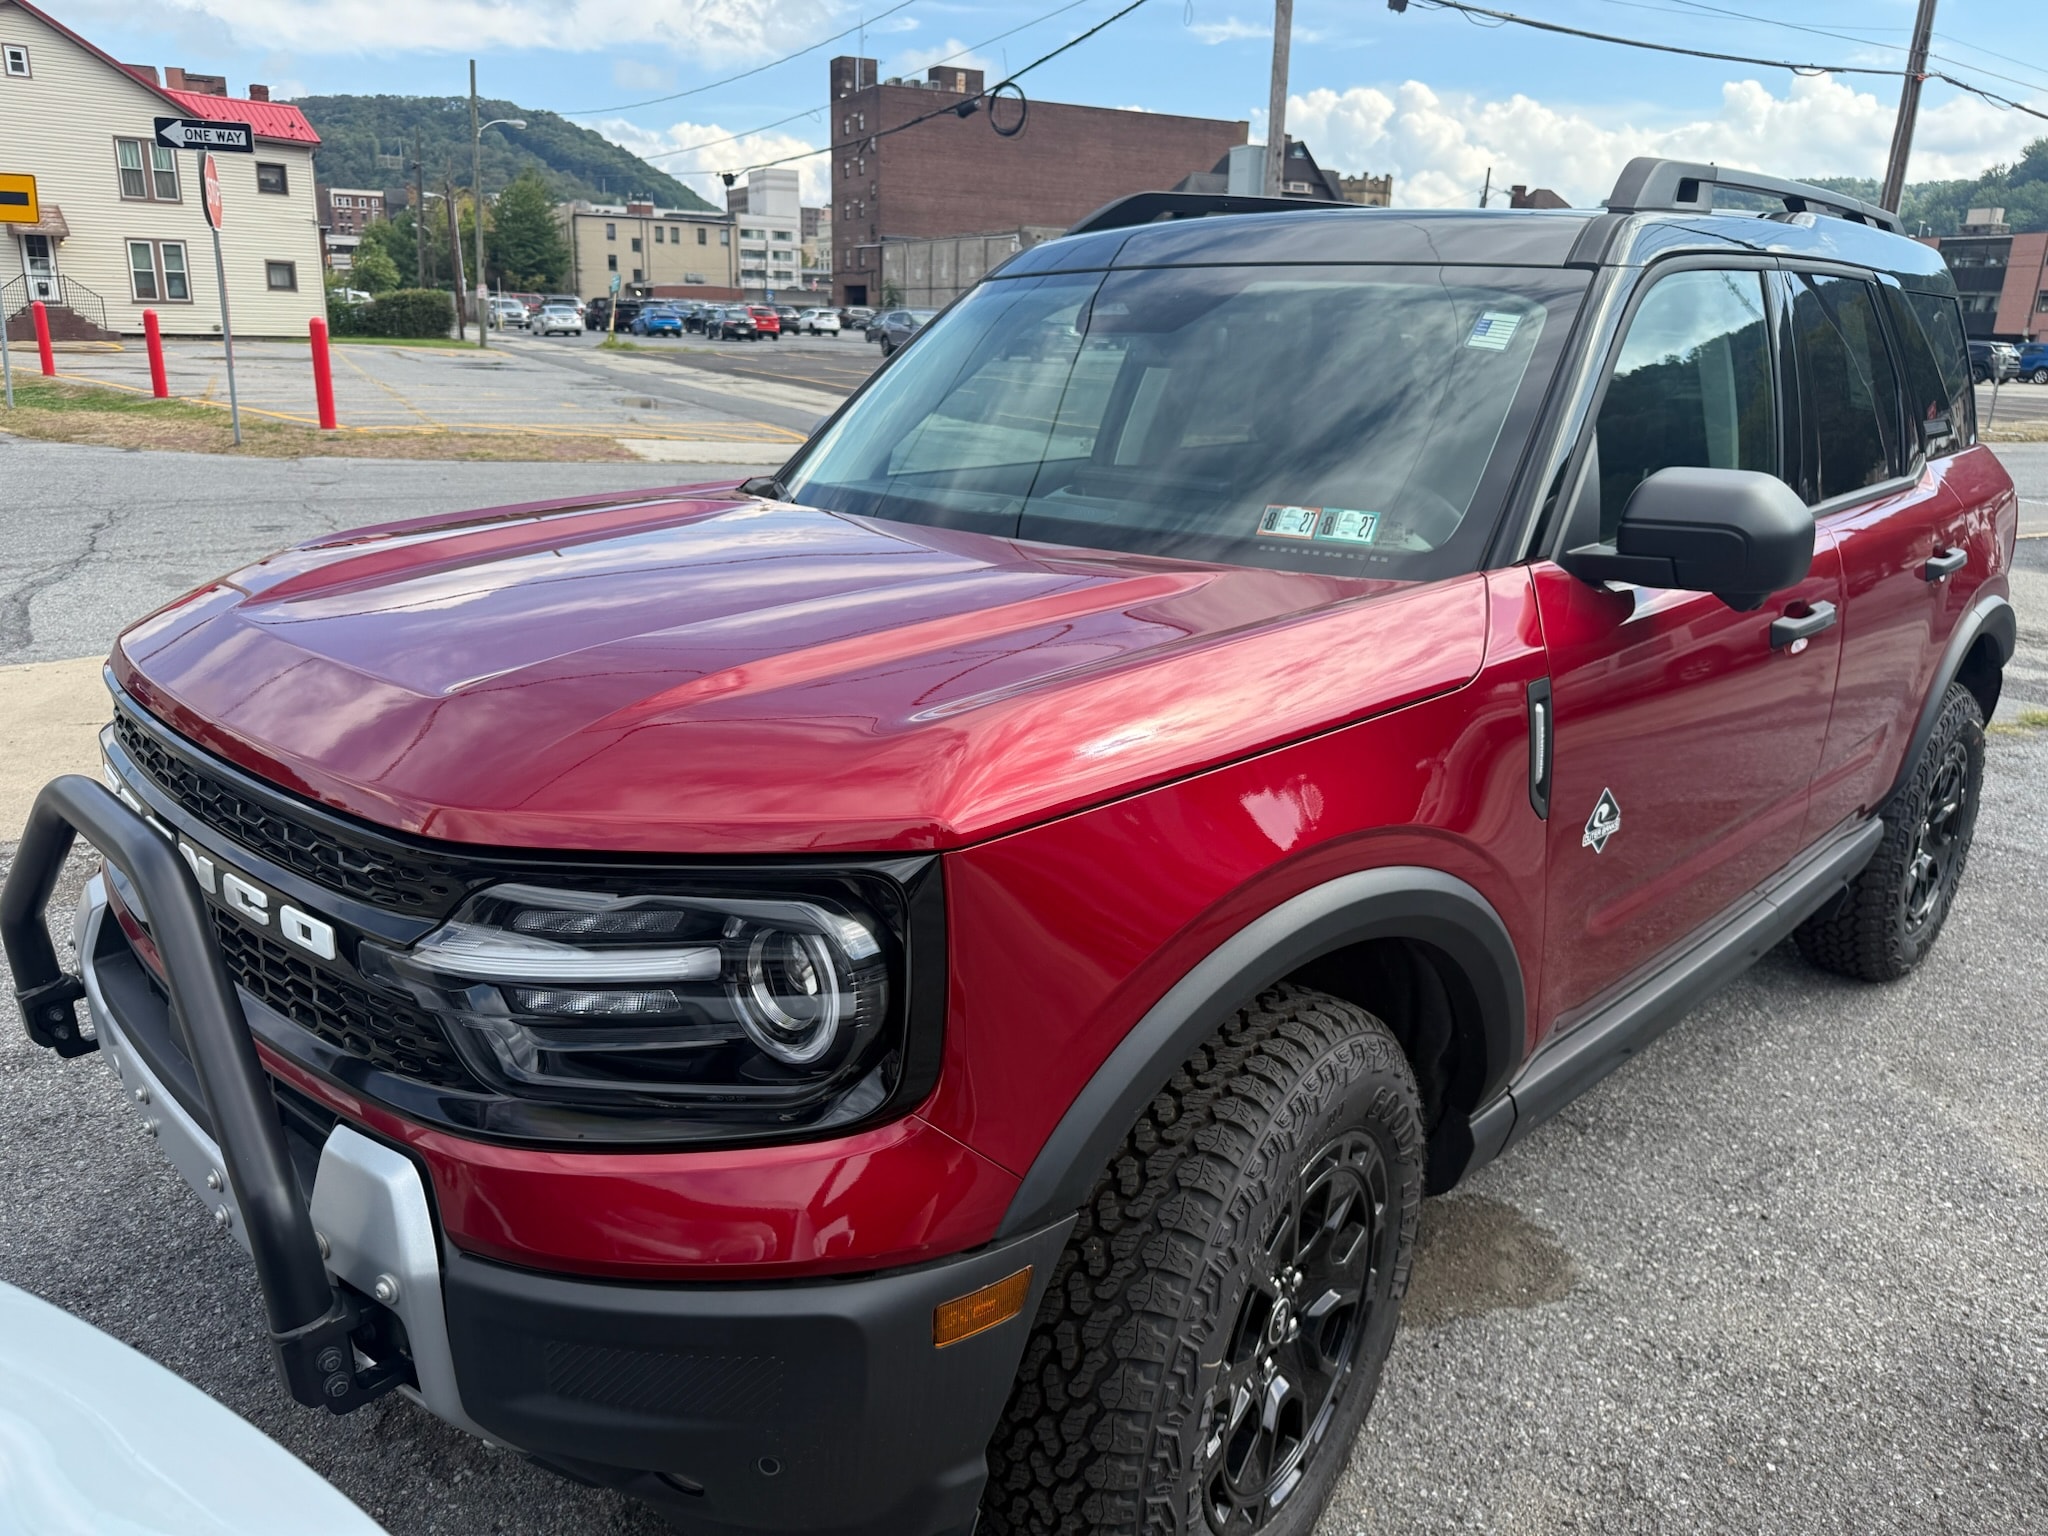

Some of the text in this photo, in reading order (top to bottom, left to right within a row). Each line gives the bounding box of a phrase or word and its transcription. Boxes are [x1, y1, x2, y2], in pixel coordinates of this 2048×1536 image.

[184, 128, 243, 144] ONE WAY
[206, 176, 220, 207] STOP
[1265, 512, 1316, 535] 8 27
[1322, 516, 1334, 536] 8
[1357, 516, 1375, 538] 27
